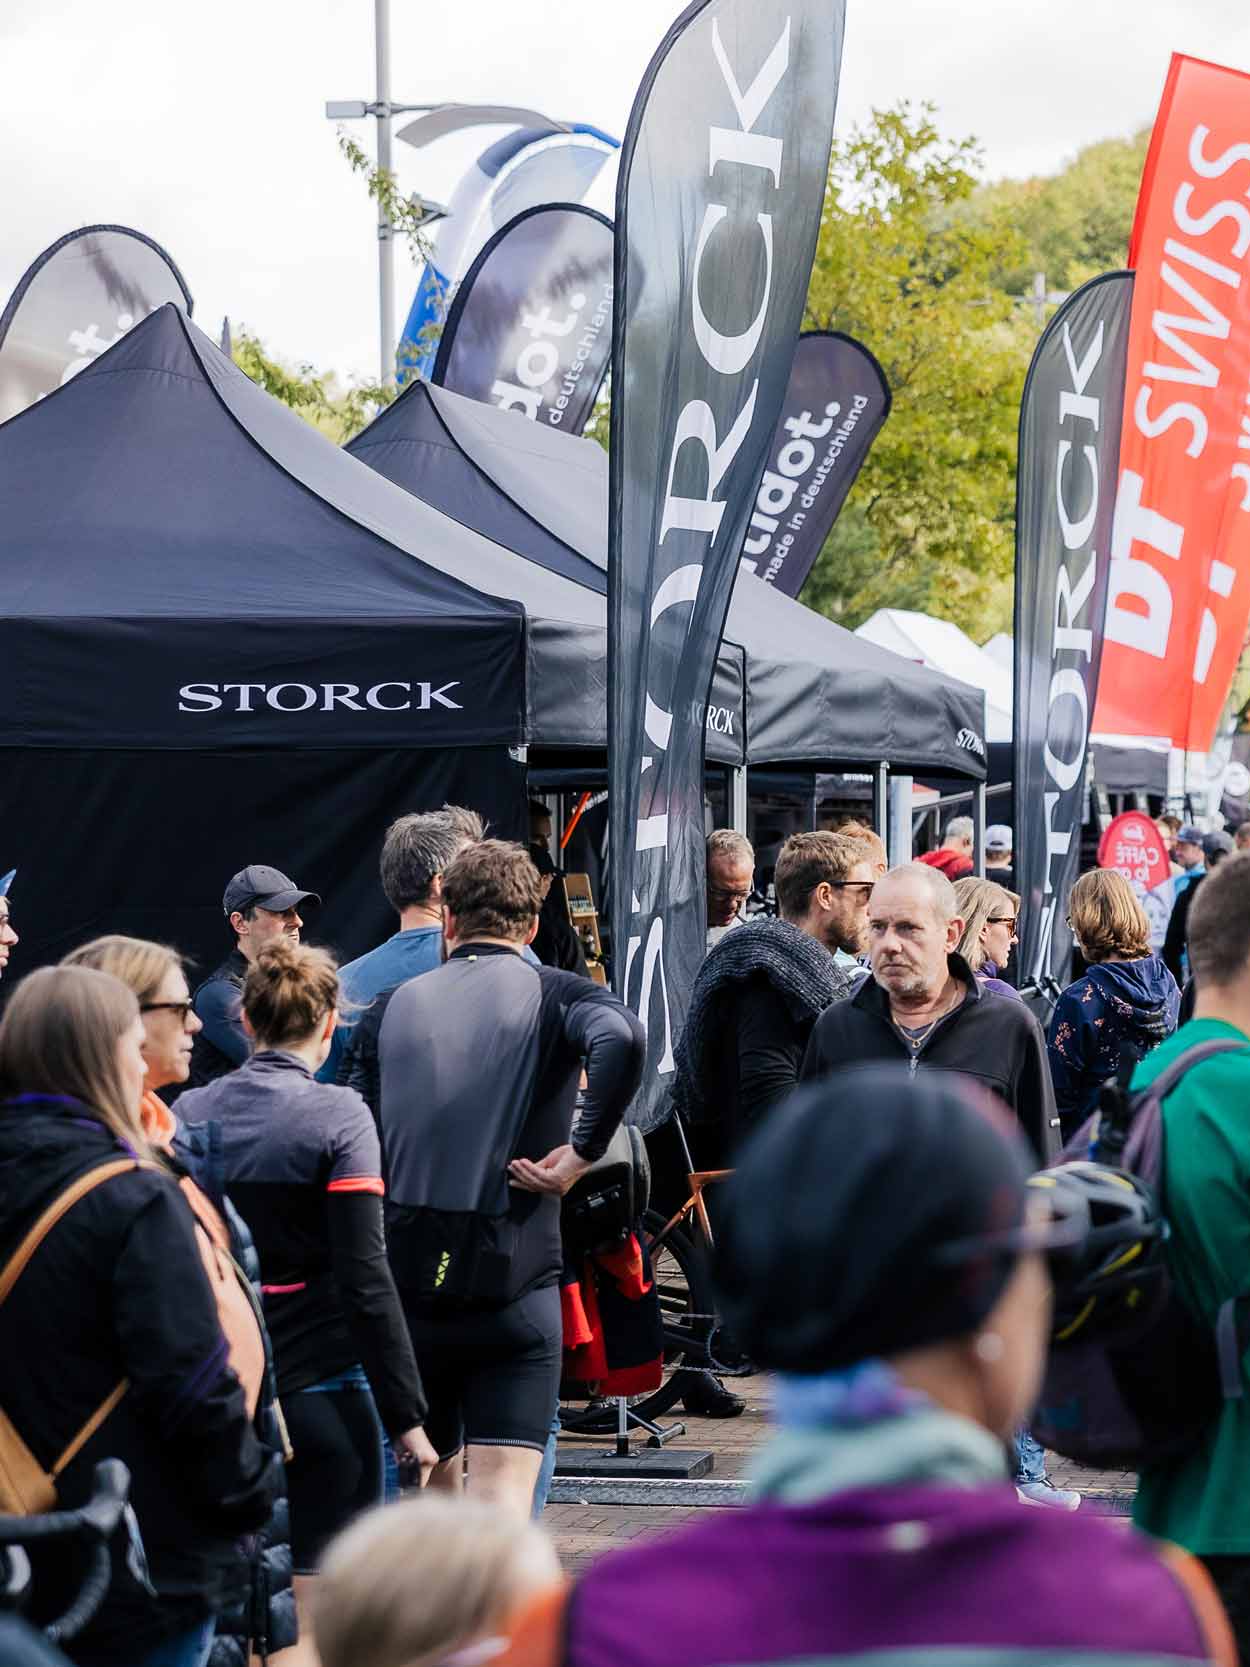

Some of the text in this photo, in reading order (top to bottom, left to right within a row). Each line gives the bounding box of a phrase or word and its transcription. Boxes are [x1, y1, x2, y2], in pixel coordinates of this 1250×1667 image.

[787, 512, 807, 530] in
[801, 394, 868, 509] deutschland
[1104, 469, 1185, 659] DT
[178, 681, 464, 713] STORCK
